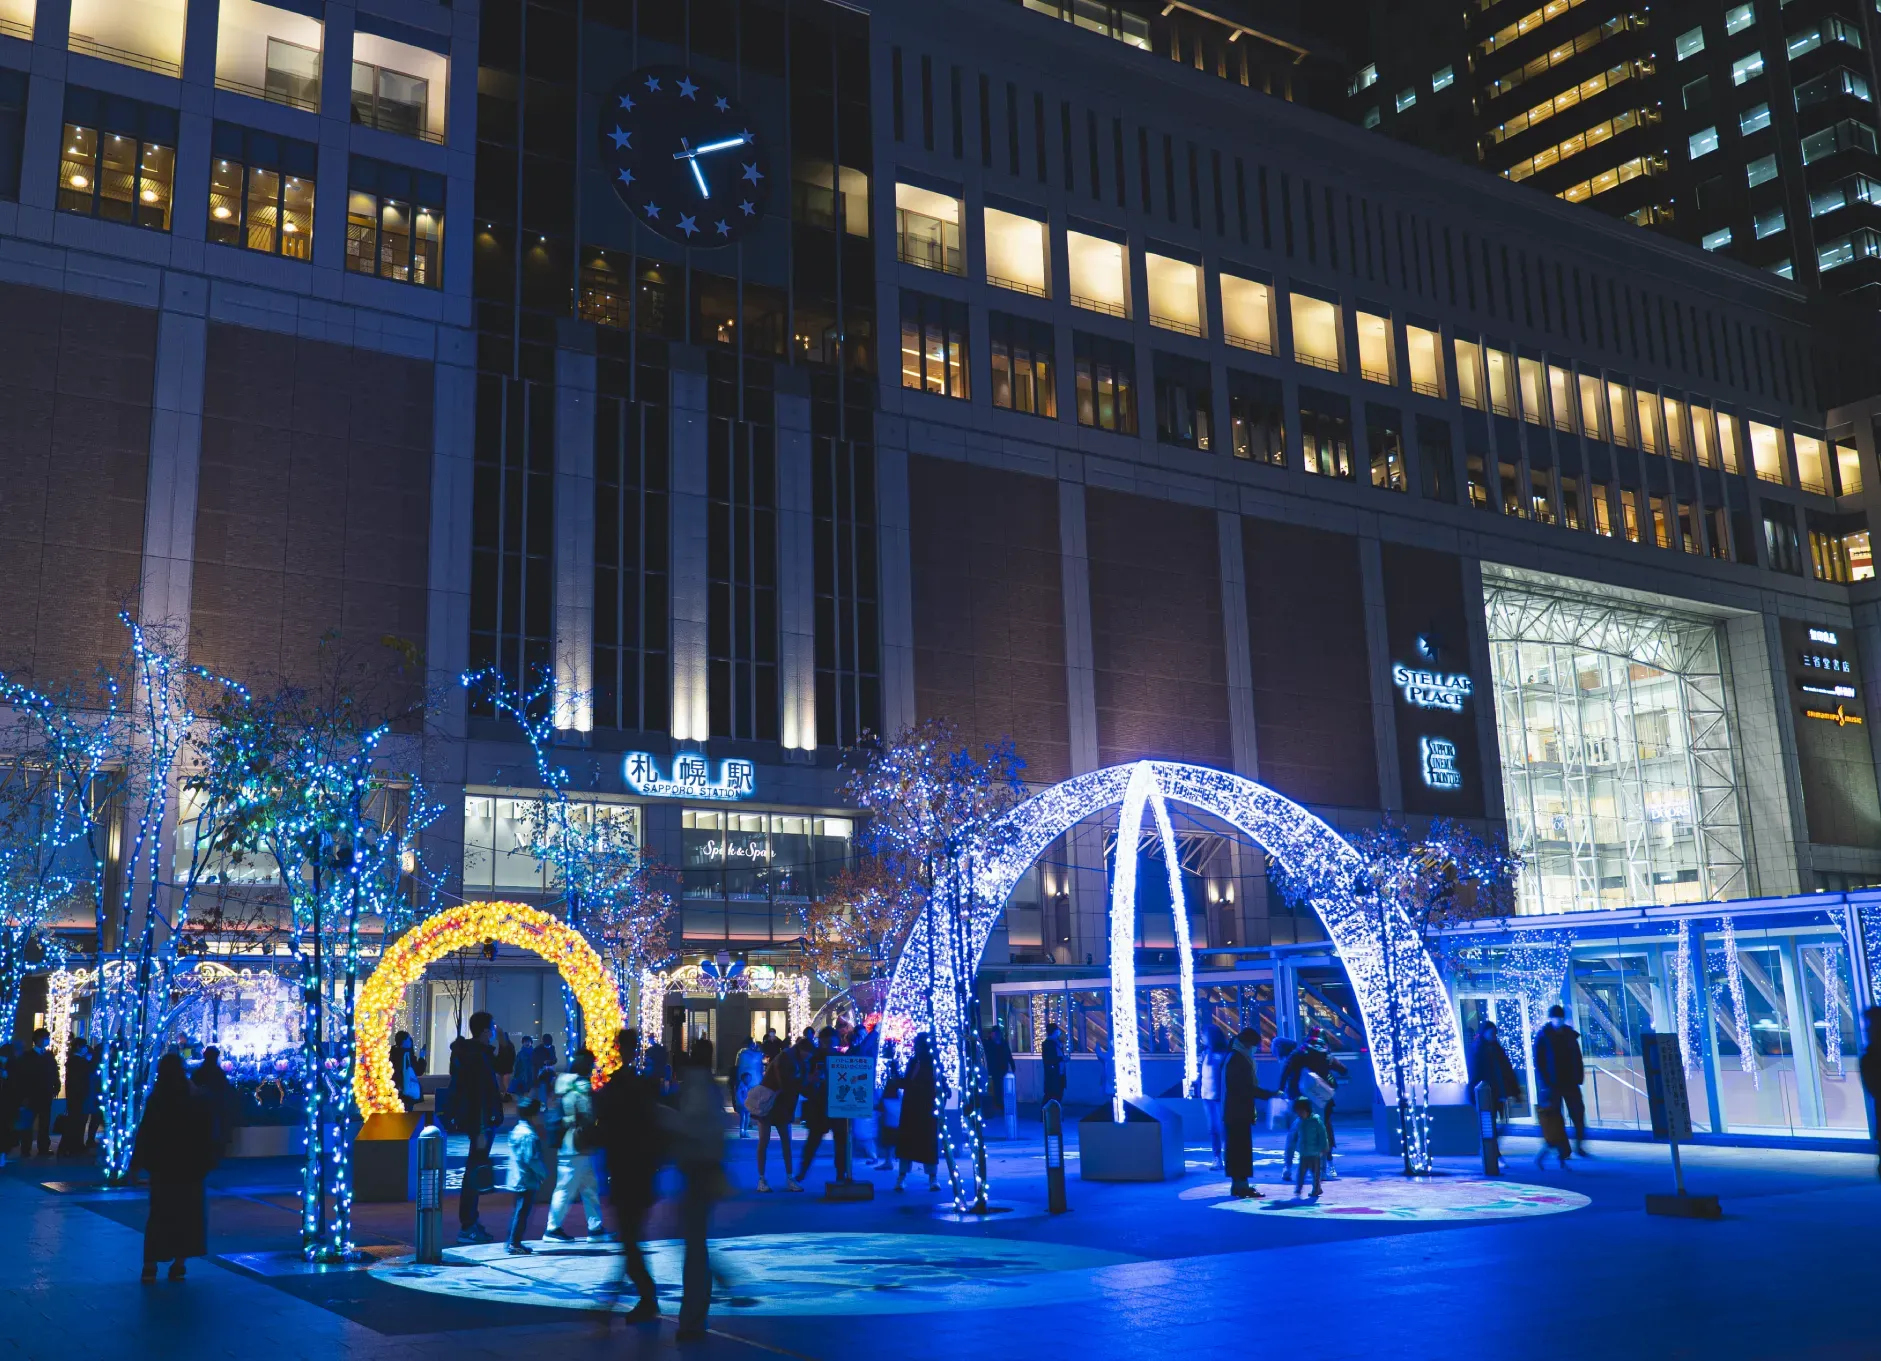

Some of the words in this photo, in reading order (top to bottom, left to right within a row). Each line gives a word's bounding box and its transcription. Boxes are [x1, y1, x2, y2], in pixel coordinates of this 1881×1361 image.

[1397, 668, 1474, 691] STELLAR
[1410, 687, 1464, 706] PLACE
[631, 754, 753, 791] 札幌駅
[643, 783, 694, 795] SAPPORO
[700, 787, 742, 798] STATION
